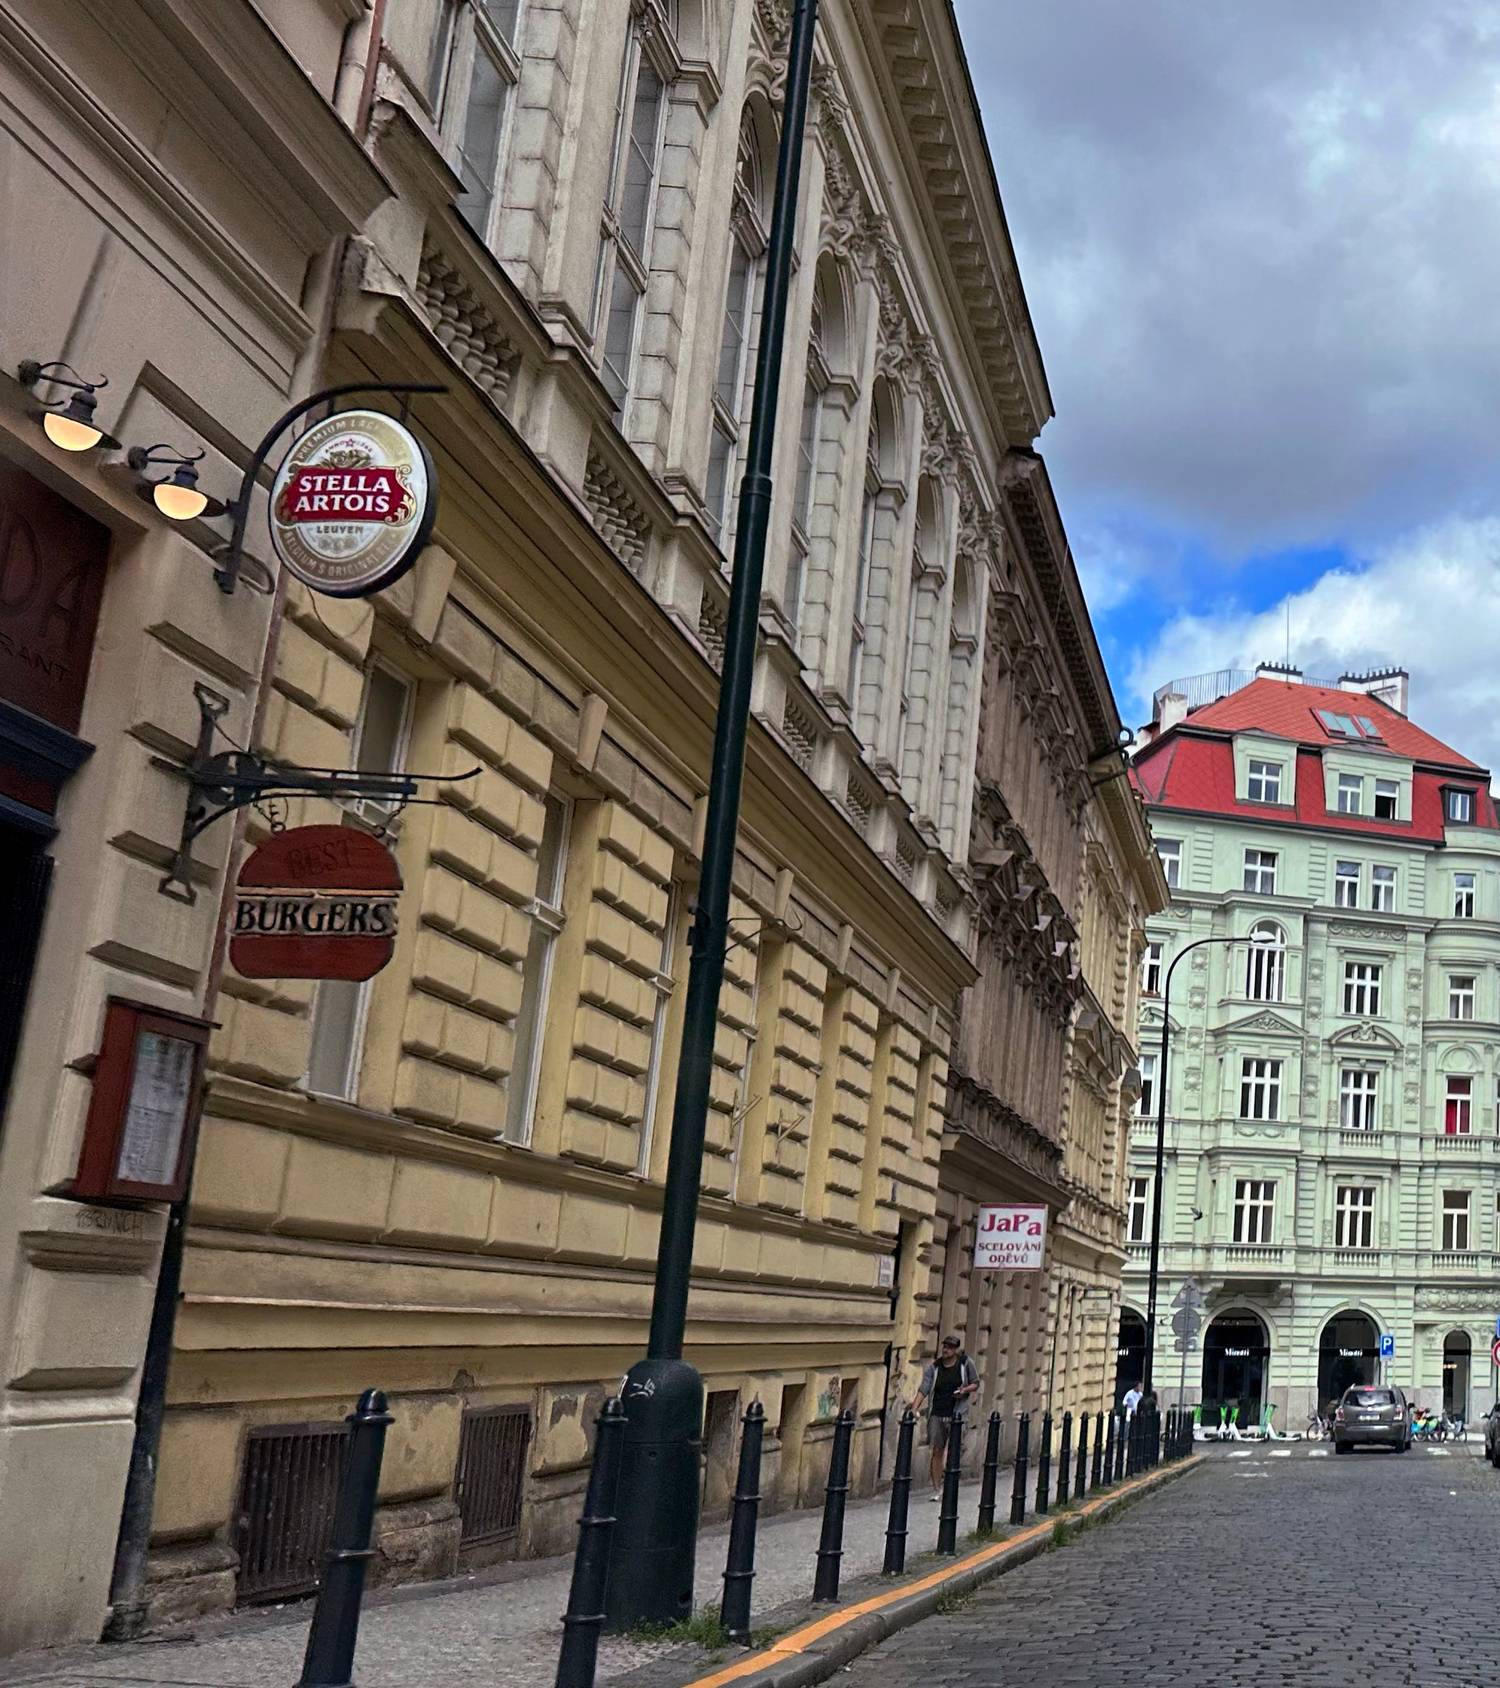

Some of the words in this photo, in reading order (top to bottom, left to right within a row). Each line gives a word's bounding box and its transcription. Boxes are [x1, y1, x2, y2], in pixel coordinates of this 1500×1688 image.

[299, 475, 392, 494] STELLA
[295, 494, 391, 513] ARTOIS
[316, 525, 364, 535] LEUVEN
[288, 838, 354, 880] BEST
[234, 900, 392, 933] BURGERS
[980, 1213, 1042, 1237] JaPa
[977, 1240, 1042, 1252] SCELOVÁNÍ
[988, 1251, 1029, 1265] ODĚVŮ
